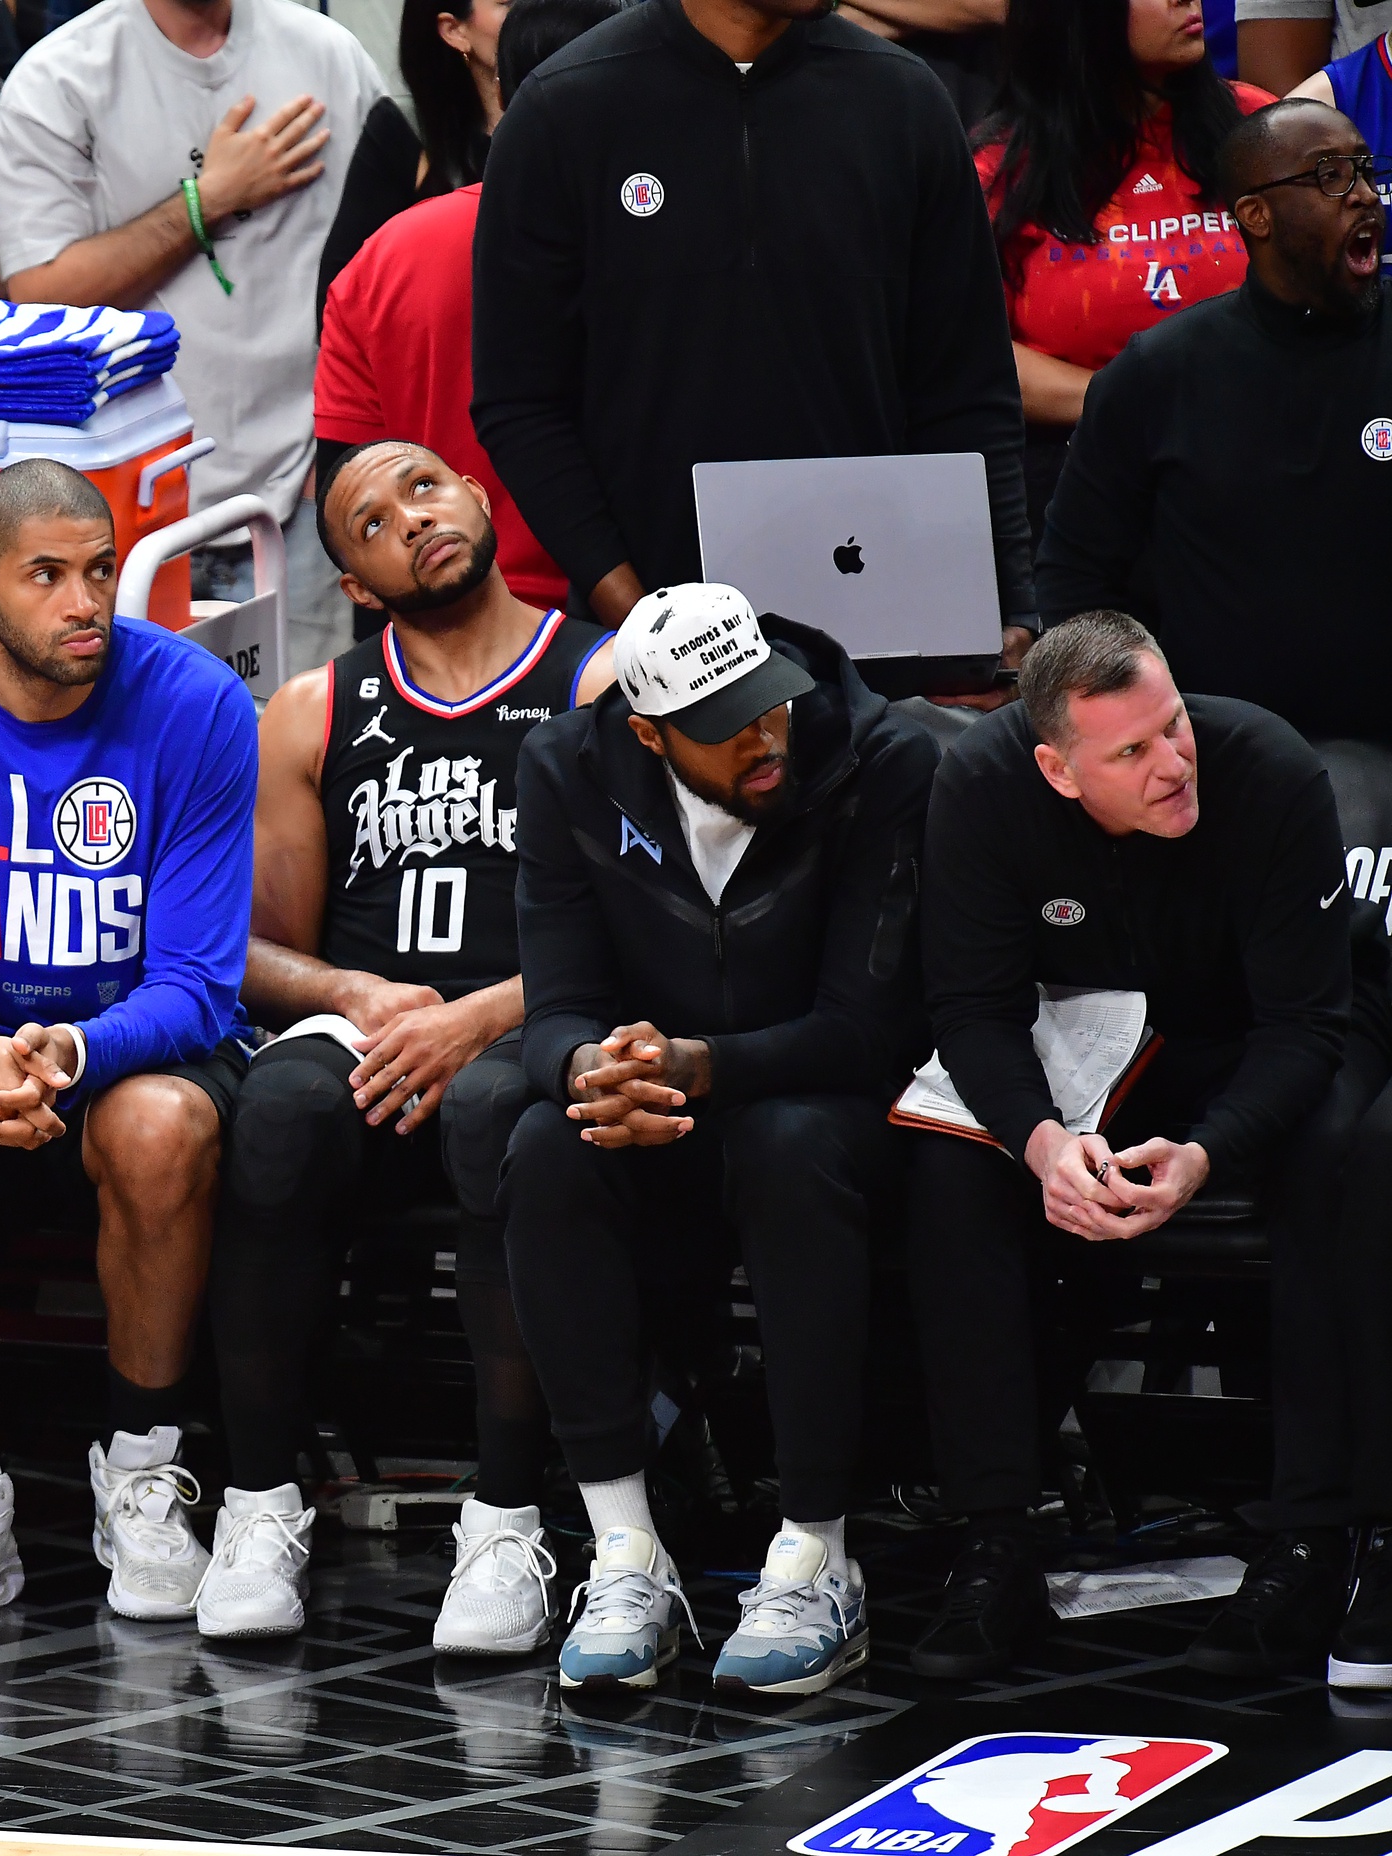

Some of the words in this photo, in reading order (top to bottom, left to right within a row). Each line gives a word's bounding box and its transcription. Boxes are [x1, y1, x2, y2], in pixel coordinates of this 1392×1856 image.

[1133, 184, 1163, 194] adidas
[359, 677, 380, 698] 6
[496, 704, 551, 722] honey
[380, 746, 482, 808] Los
[397, 867, 467, 953] 10
[2, 981, 72, 996] CLIPPERS
[830, 1828, 970, 1854] NBA
